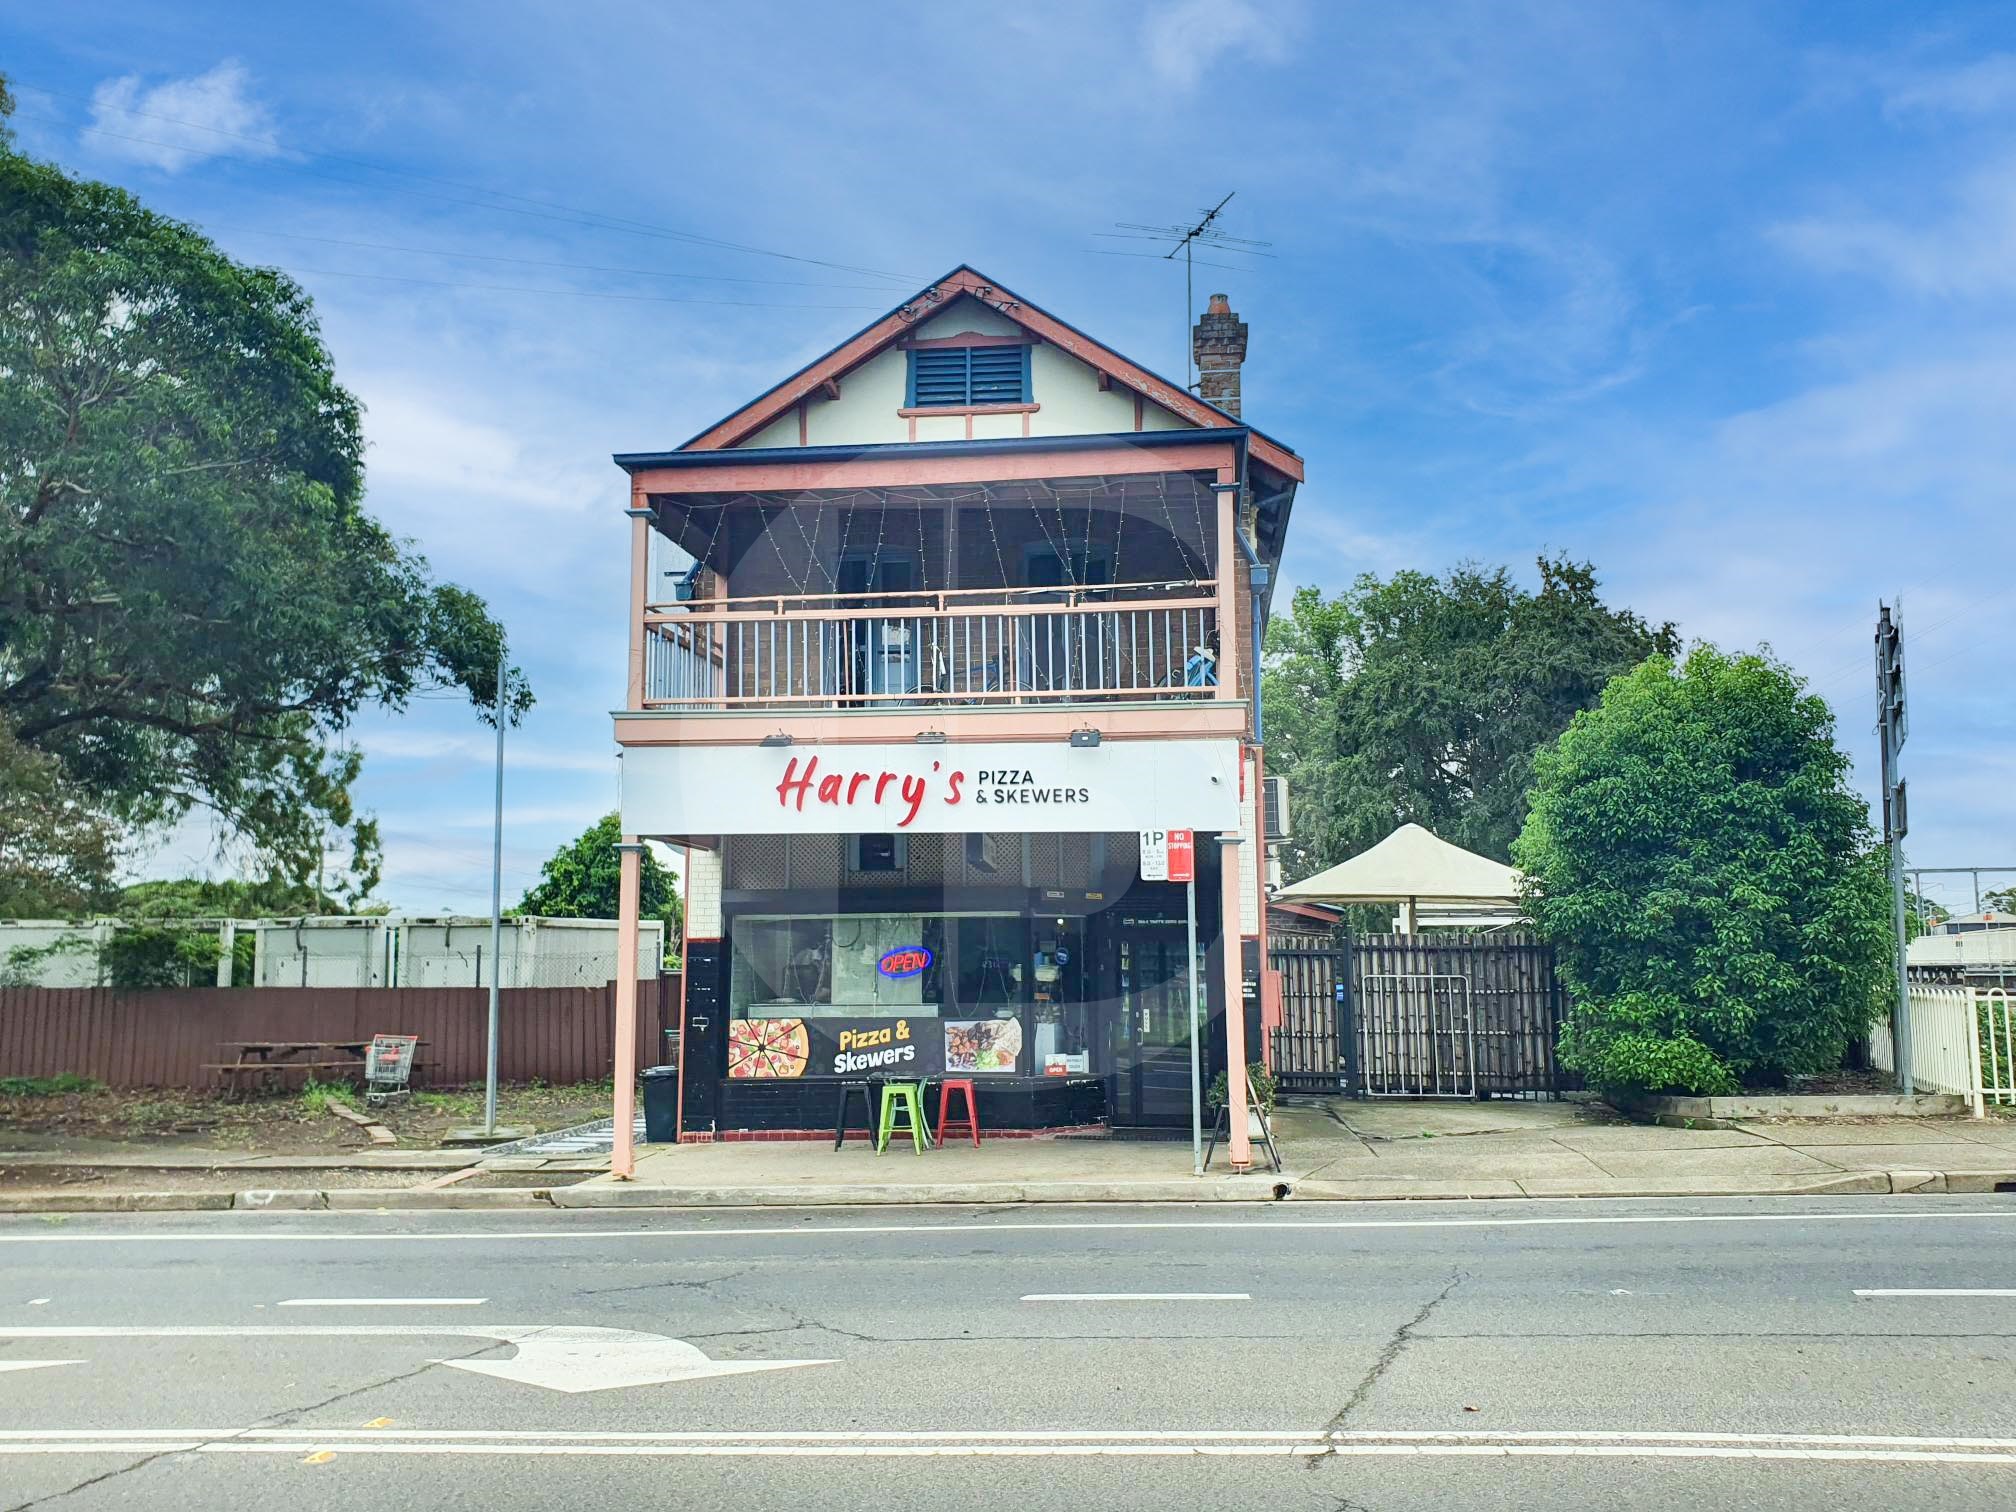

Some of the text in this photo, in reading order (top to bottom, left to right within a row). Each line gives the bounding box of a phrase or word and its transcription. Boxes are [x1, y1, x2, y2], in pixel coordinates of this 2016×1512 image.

[978, 770, 1034, 785] PIZZA
[776, 755, 965, 827] Harry's
[976, 788, 1090, 804] & SKEWERS
[1142, 831, 1164, 846] 1P
[1174, 833, 1185, 841] NO
[882, 951, 927, 973] OPEN
[839, 1019, 910, 1051] Pizza &
[834, 1044, 915, 1074] Skewers
